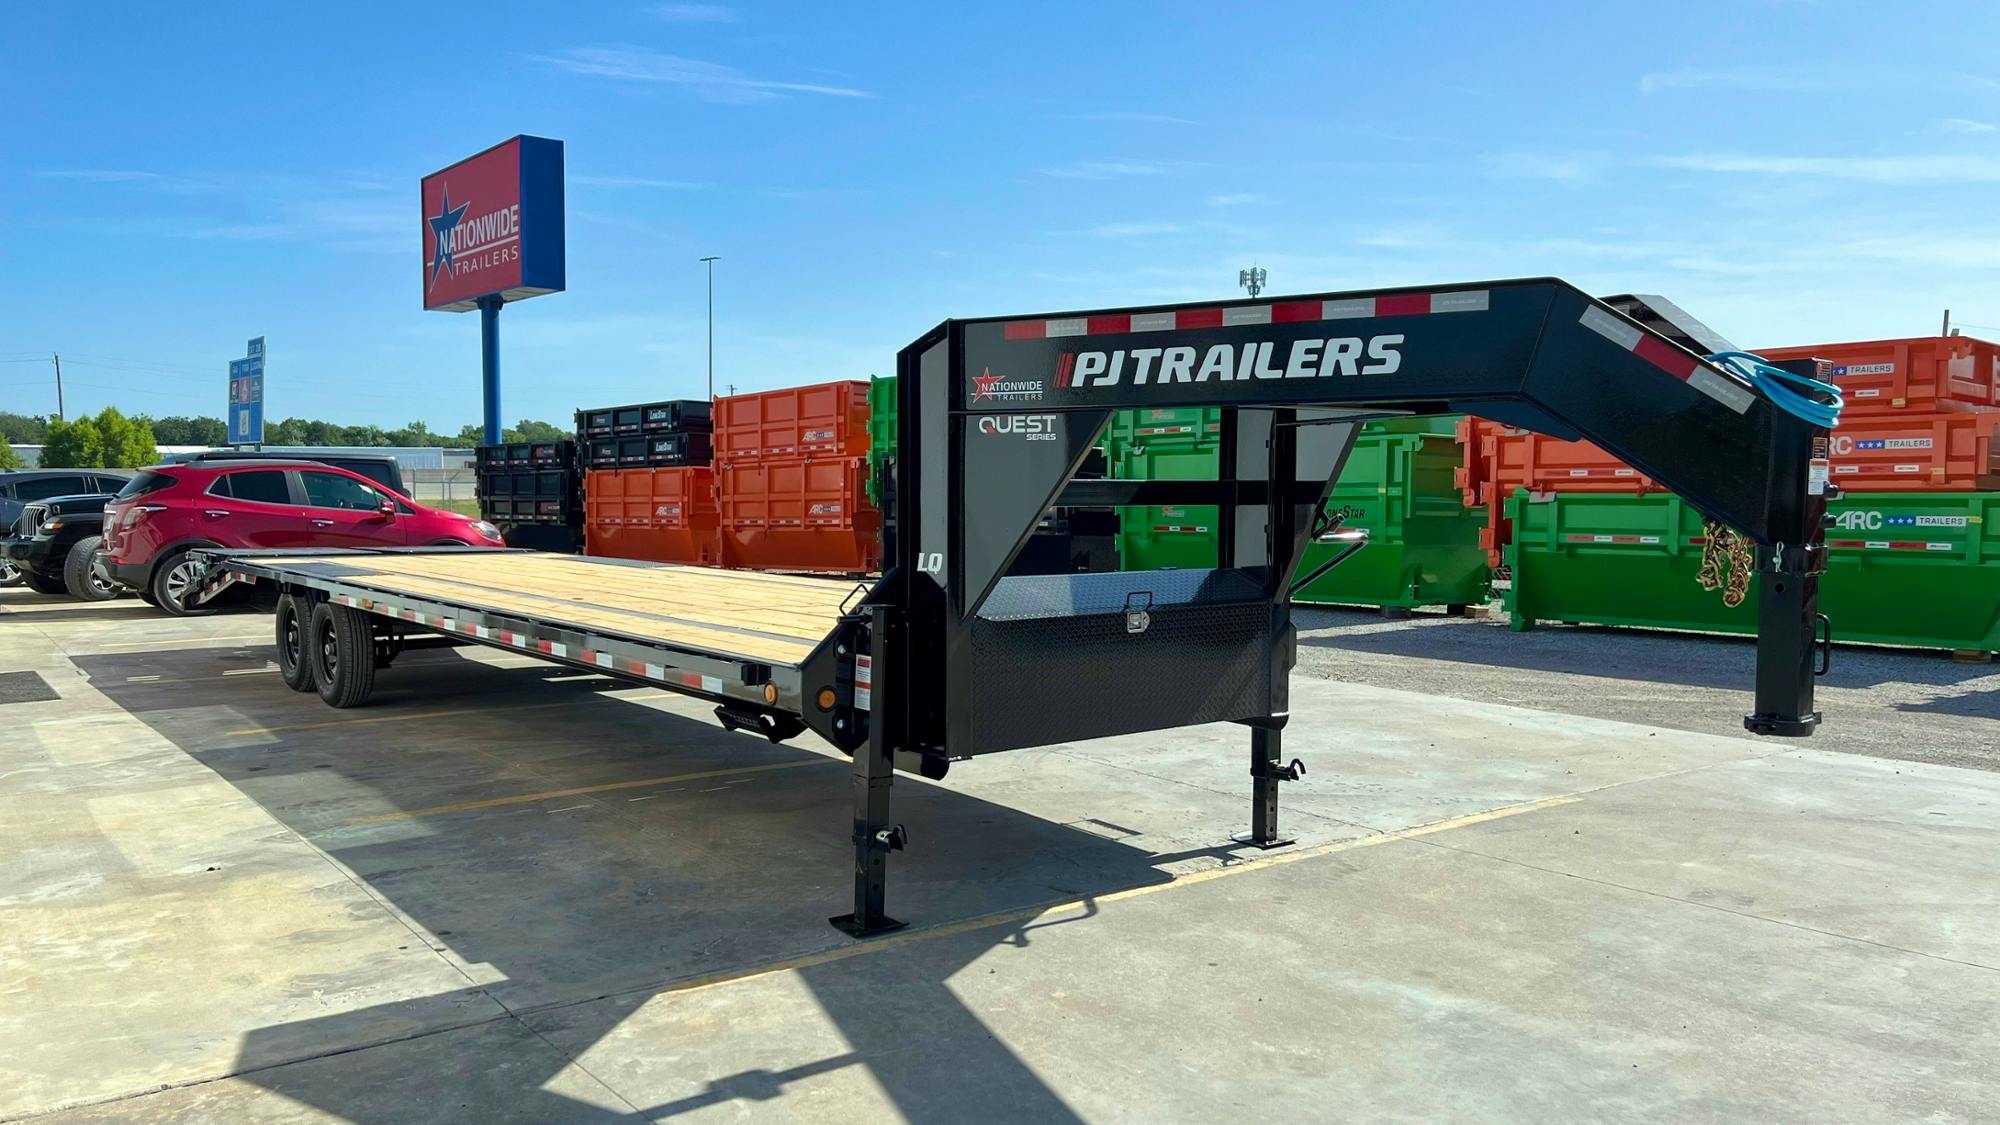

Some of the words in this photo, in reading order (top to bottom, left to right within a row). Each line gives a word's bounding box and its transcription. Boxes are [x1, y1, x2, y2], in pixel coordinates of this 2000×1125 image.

[440, 204, 519, 256] NATIONWIDE
[454, 245, 518, 276] TRAILERS
[1850, 364, 1891, 374] TRAILERS
[981, 380, 1043, 391] NATIONWIDE
[997, 393, 1043, 401] TRAILERS
[979, 415, 1056, 434] QUEST
[1026, 433, 1056, 441] SERIES
[1888, 439, 1931, 448] TRAILERS
[1835, 511, 1882, 530] ARC
[1919, 517, 1963, 525] TRAILERS
[916, 552, 943, 575] LQ
